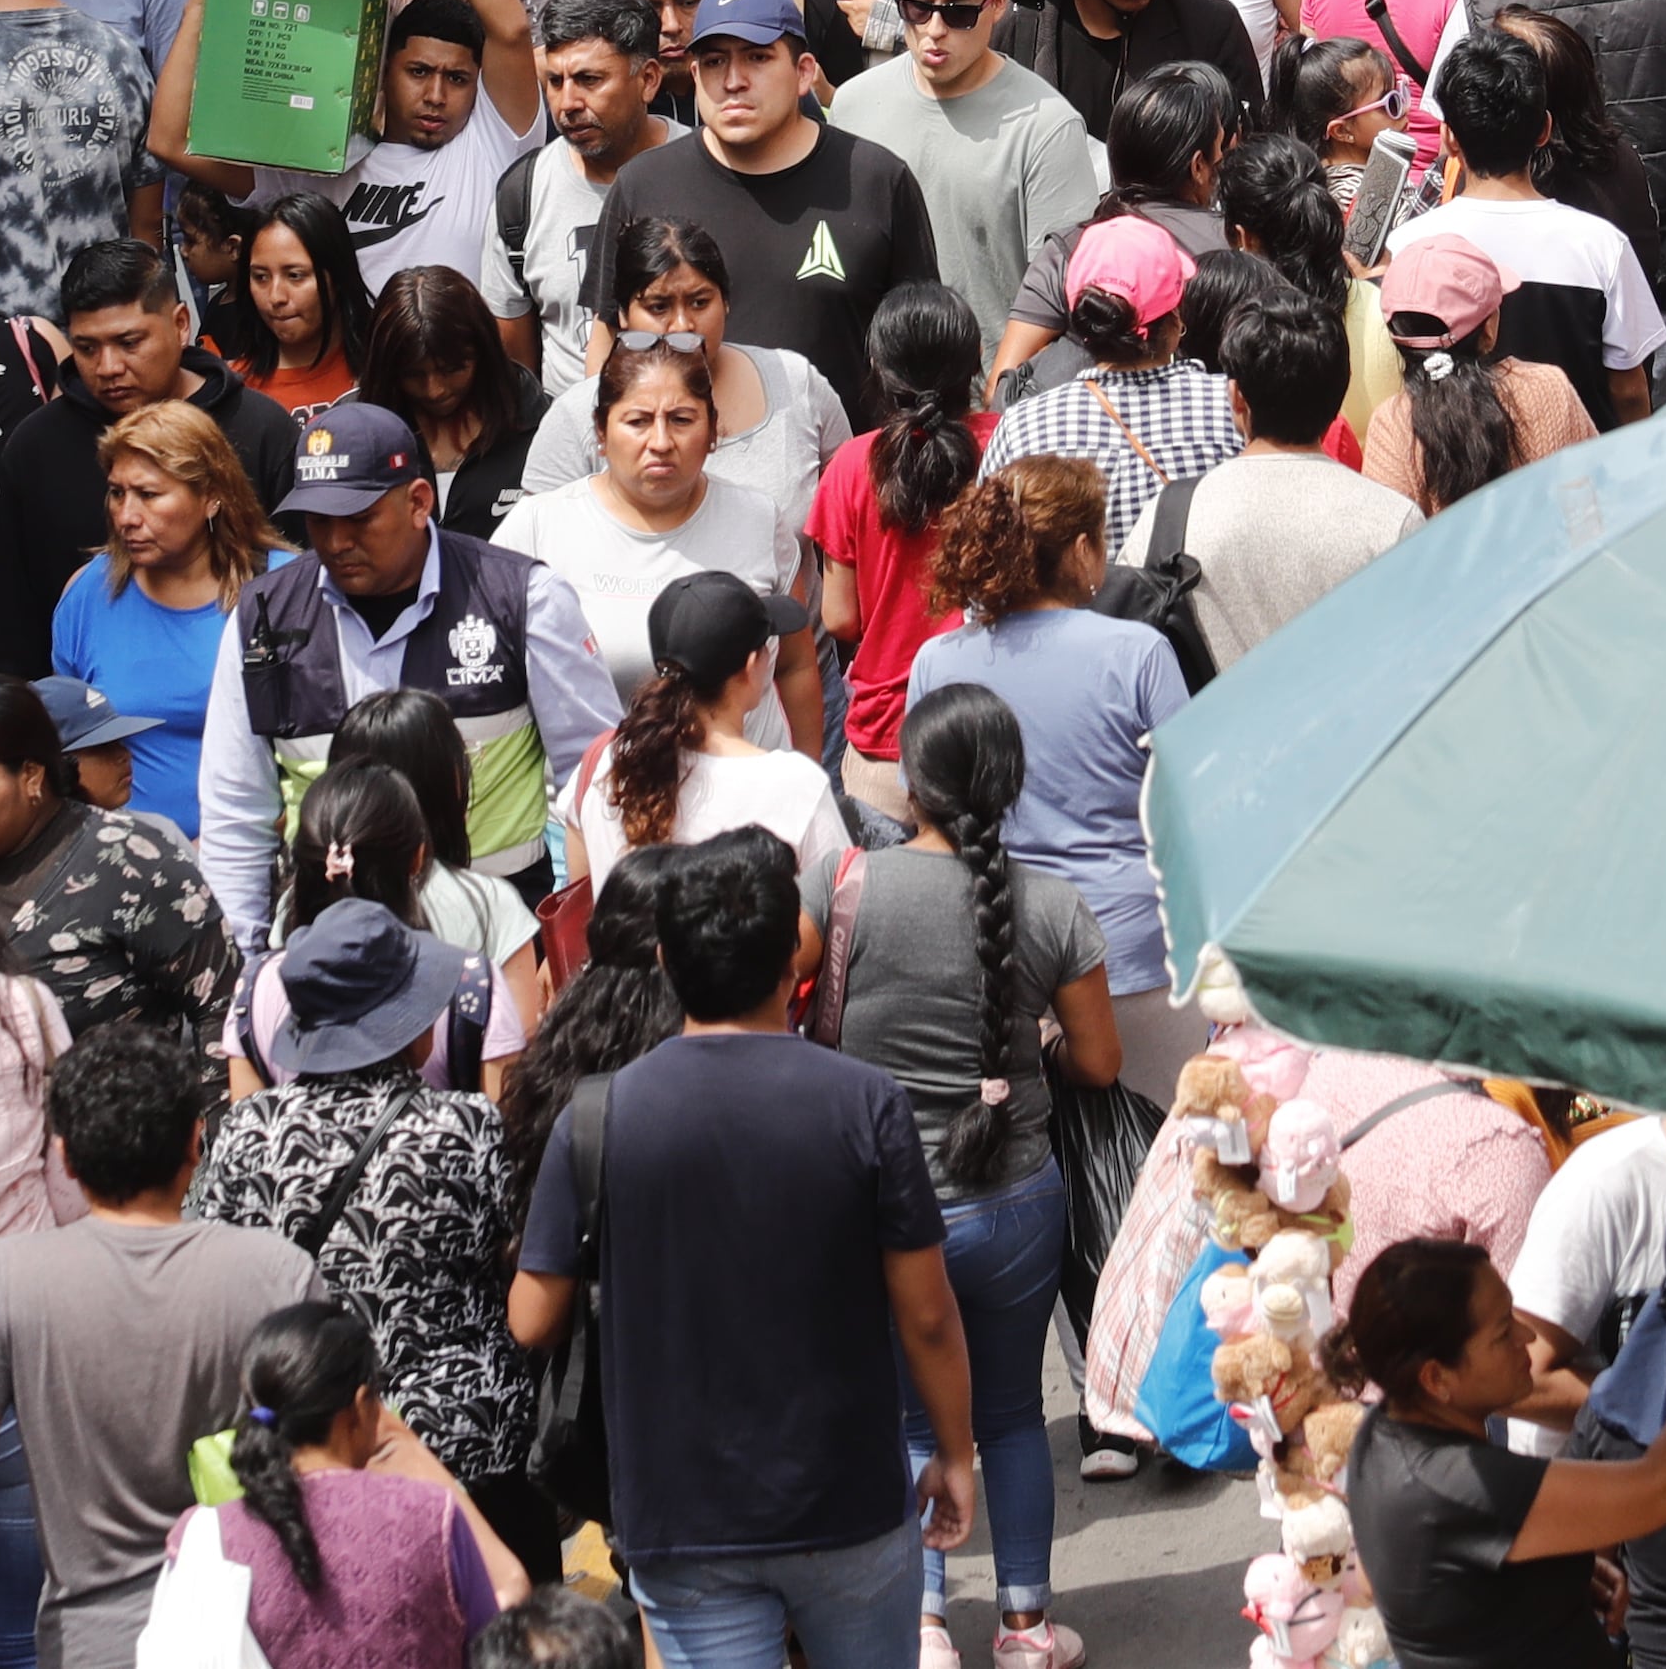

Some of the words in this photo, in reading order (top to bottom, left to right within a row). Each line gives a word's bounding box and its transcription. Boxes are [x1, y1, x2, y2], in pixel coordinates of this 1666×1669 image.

[284, 23, 298, 33] 721
[243, 67, 264, 76] MADE
[265, 69, 273, 78] IN
[273, 71, 295, 81] CHINA
[343, 180, 427, 226] NIKE
[301, 467, 339, 482] LIMA
[593, 572, 666, 596] WOR
[446, 671, 503, 686] LIMA
